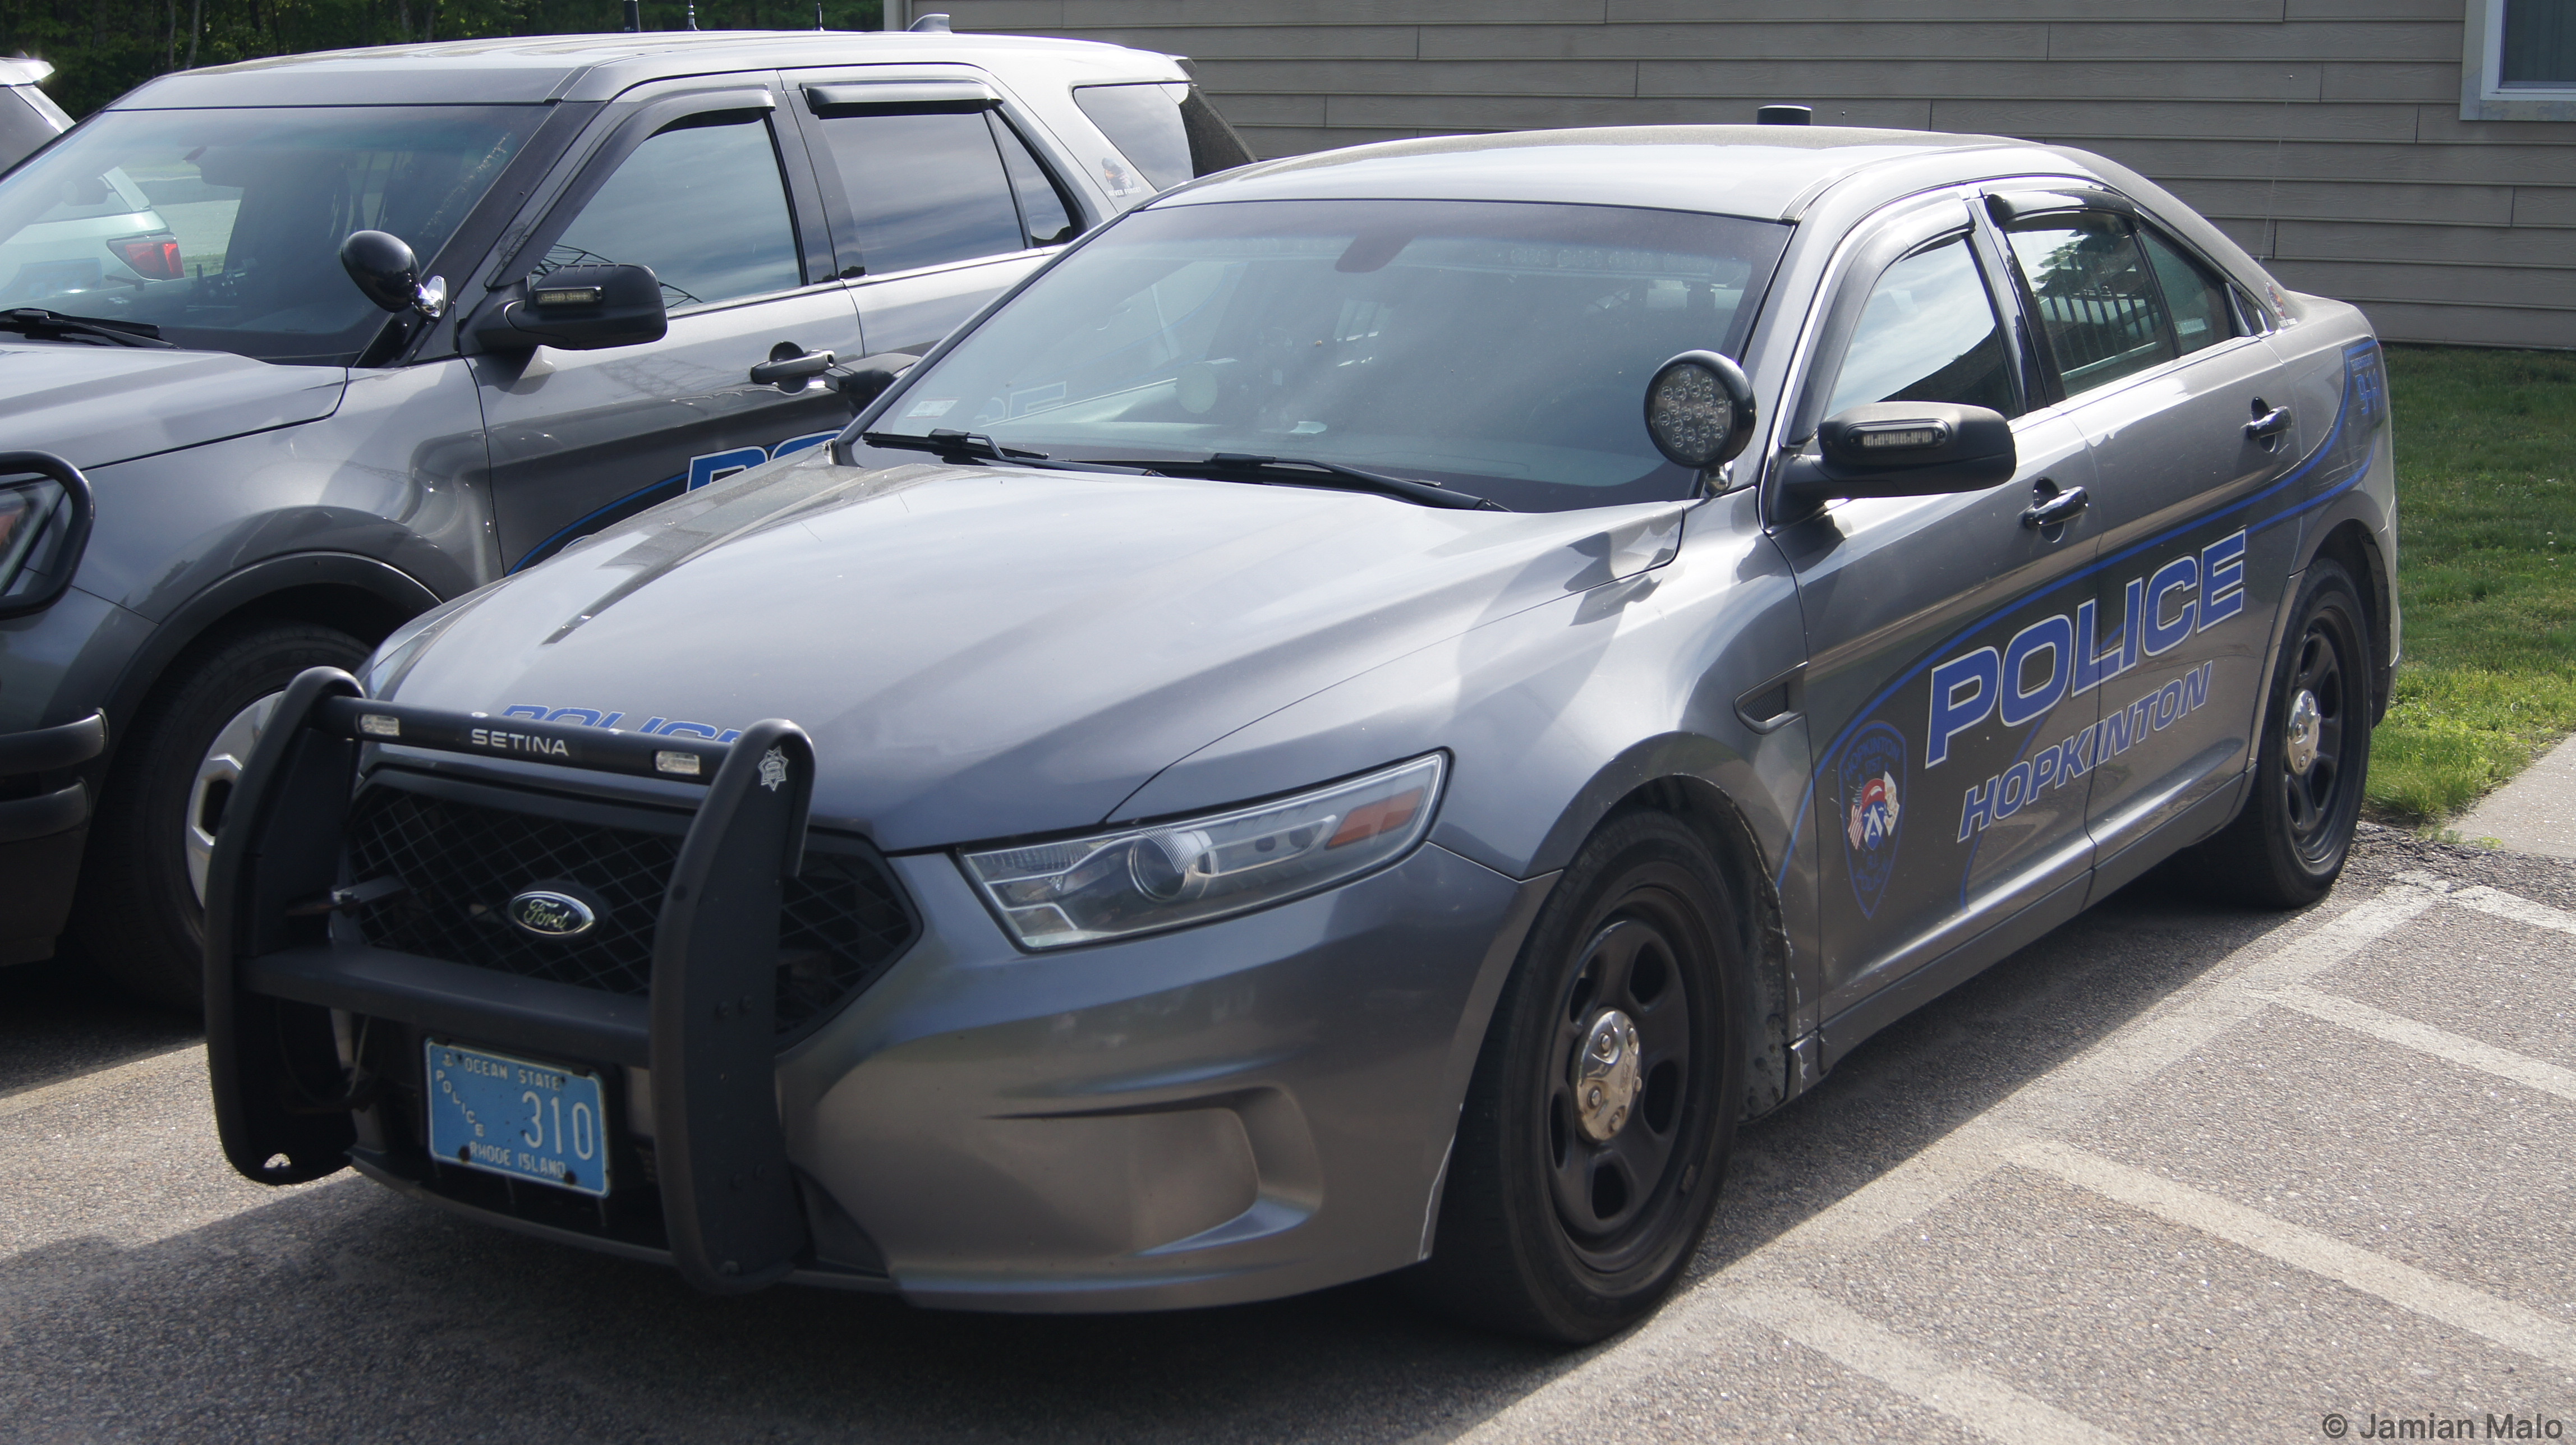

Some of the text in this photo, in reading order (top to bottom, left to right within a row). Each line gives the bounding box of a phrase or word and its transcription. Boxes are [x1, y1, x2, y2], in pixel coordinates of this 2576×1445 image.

[1925, 529, 2246, 769] POLICE
[471, 729, 569, 757] SETINA
[1844, 736, 1901, 781] HOPKINTON
[1957, 660, 2212, 844] HOPKINTON
[522, 898, 568, 932] Ford
[464, 1057, 560, 1091] OCEAN STATE
[435, 1069, 485, 1137] POLICE
[522, 1090, 594, 1161] 310
[469, 1141, 566, 1178] RHODE ISLAND
